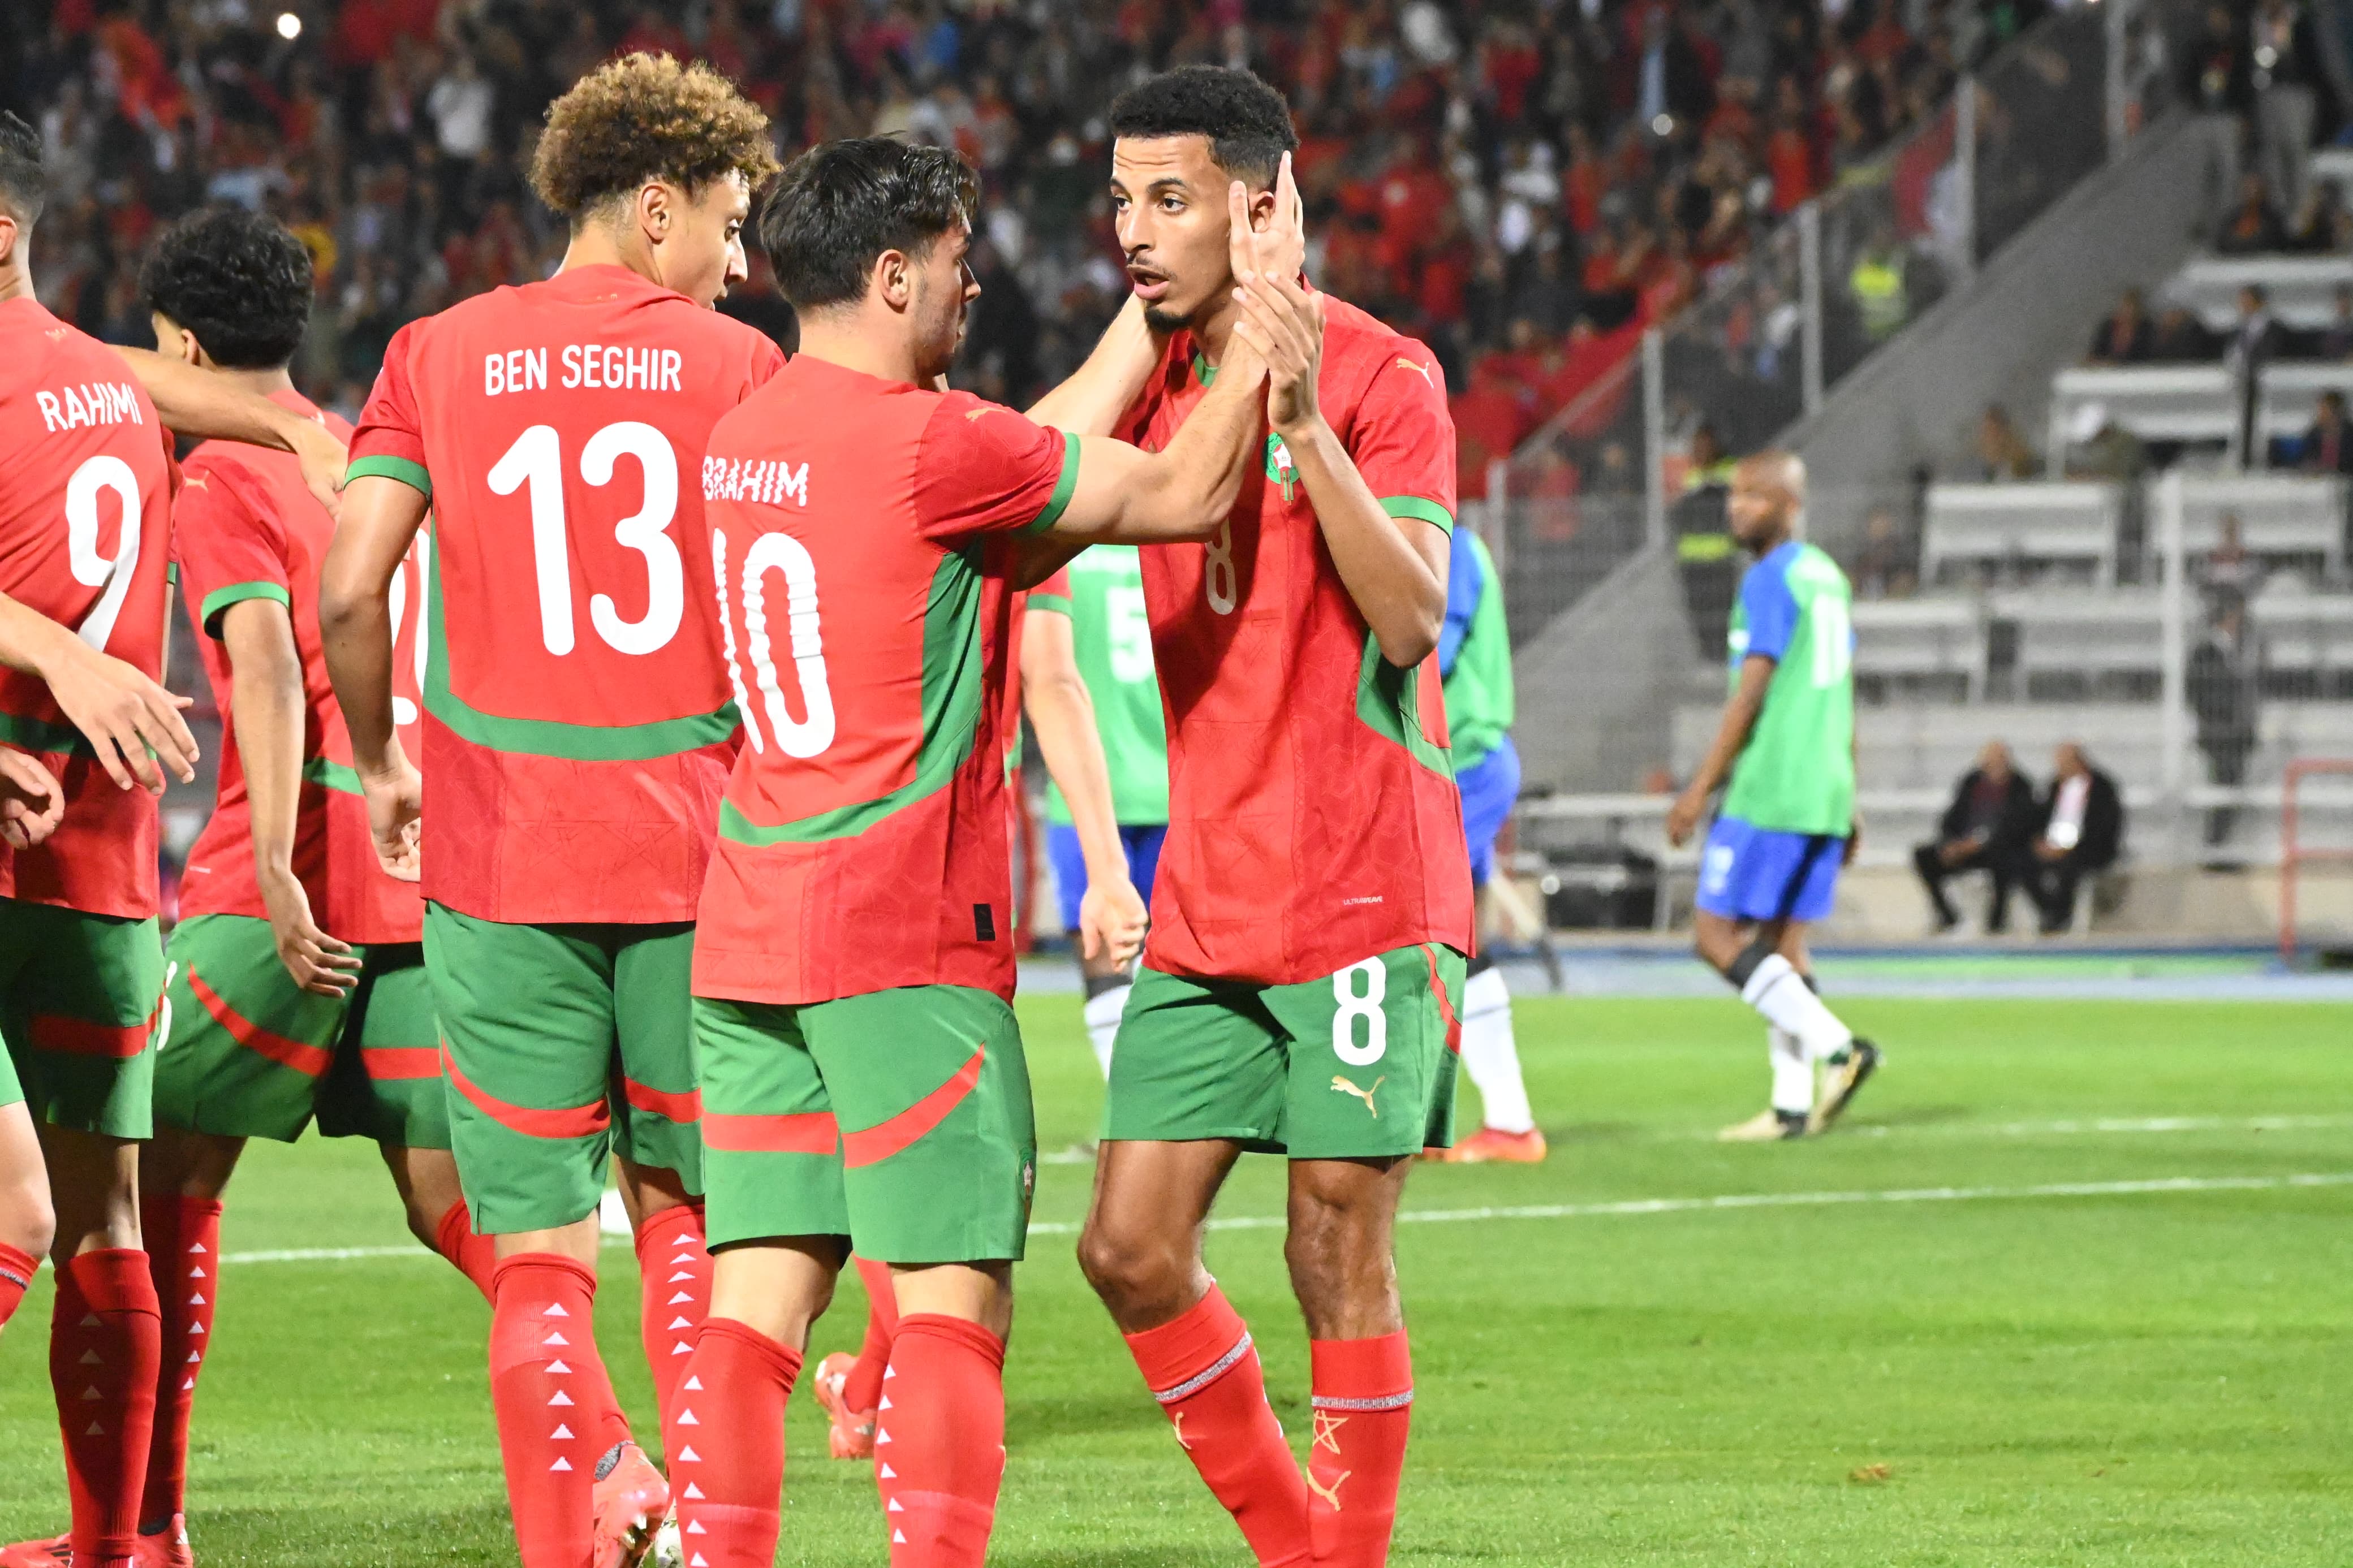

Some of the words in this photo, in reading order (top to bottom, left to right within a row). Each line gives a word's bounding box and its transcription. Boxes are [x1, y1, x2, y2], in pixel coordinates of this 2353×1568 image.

[36, 382, 144, 432] RAHIMI
[485, 347, 548, 396] BEN
[561, 344, 683, 392] SEGHIR
[702, 455, 809, 507] BRAHIM
[65, 455, 141, 653] 9
[486, 421, 684, 656] 13
[1205, 517, 1237, 615] 8
[712, 527, 837, 759] 10
[1105, 586, 1154, 682] 5
[1343, 896, 1383, 905] ULTRAWEAVE
[1332, 955, 1387, 1066] 8
